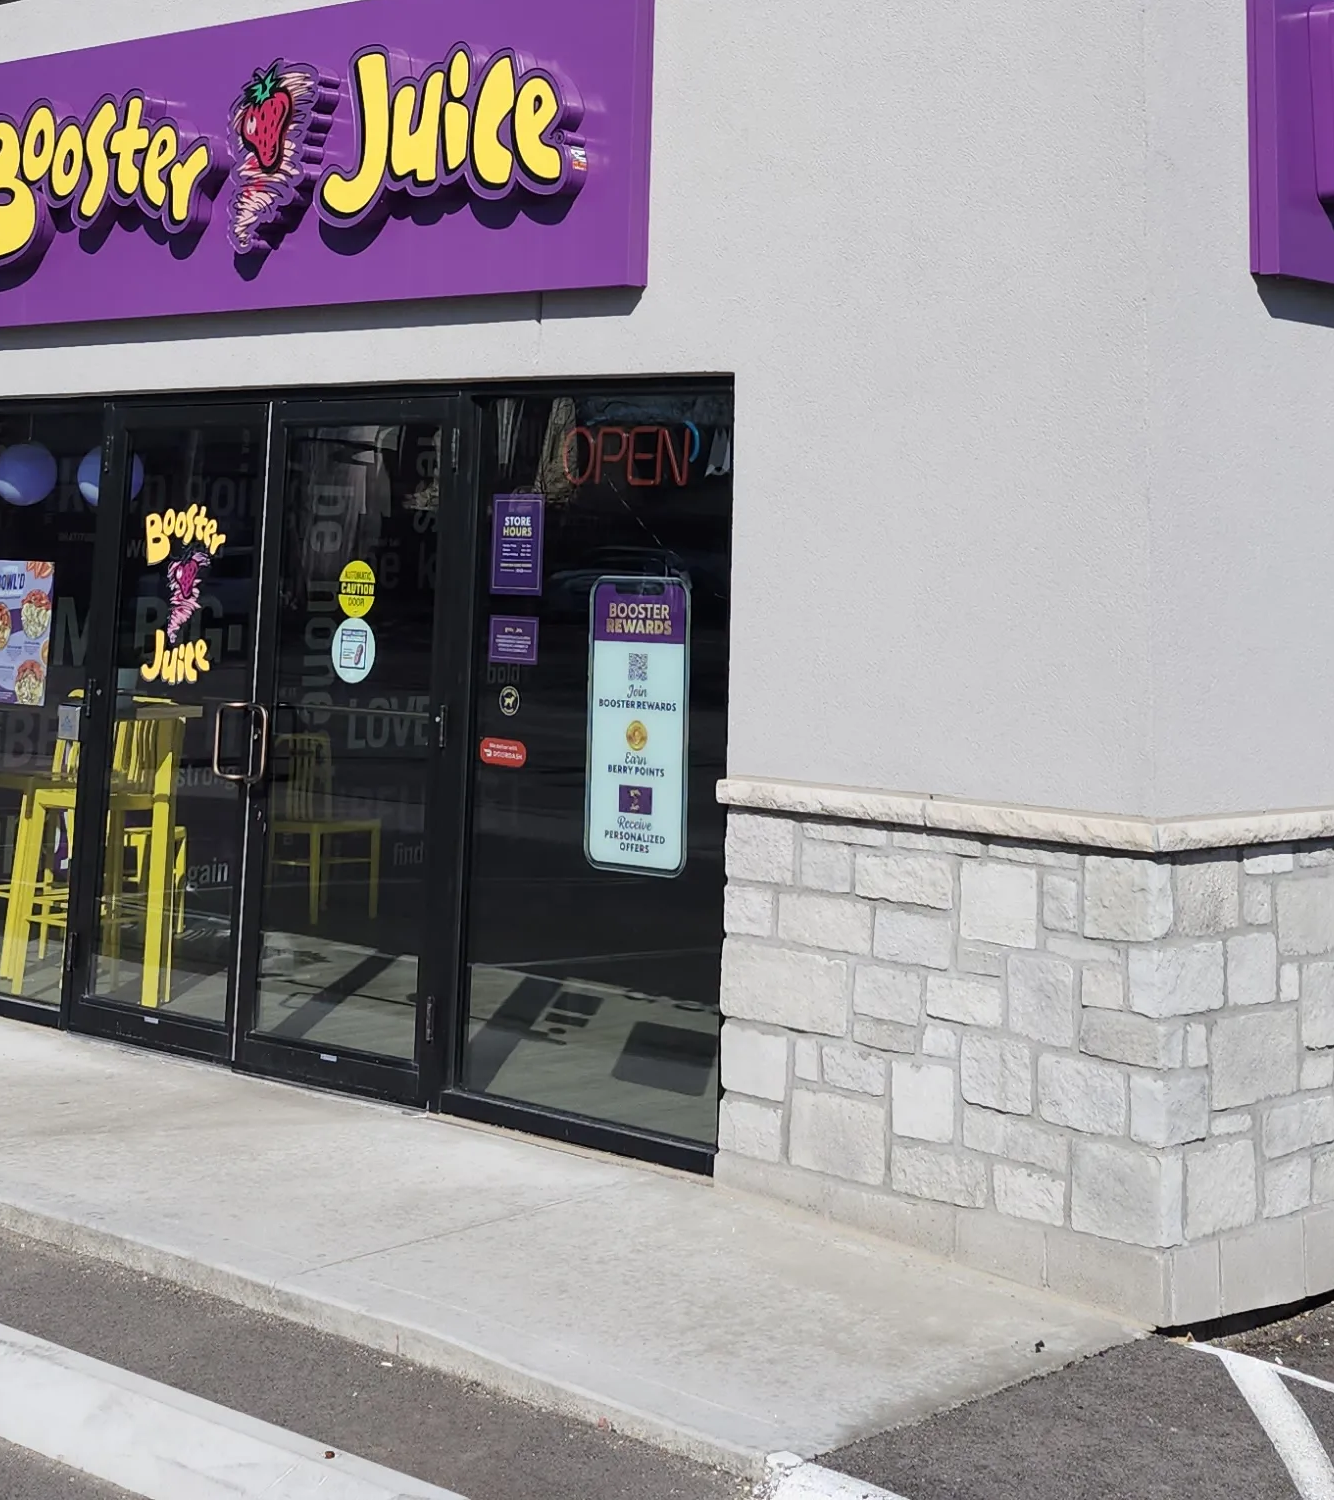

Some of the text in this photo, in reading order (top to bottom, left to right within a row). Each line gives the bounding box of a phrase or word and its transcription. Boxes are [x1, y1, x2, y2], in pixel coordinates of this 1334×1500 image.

[323, 50, 563, 214] Juice
[563, 425, 692, 487] OPEN
[504, 516, 532, 527] STORE
[146, 503, 226, 567] Booster
[503, 526, 533, 537] HOURS
[341, 582, 375, 596] CAUTION
[348, 597, 365, 608] DOOR
[609, 602, 670, 619] BOOSTER
[606, 618, 672, 636] REWARDS
[140, 628, 211, 686] Juice
[627, 684, 647, 699] Join
[598, 698, 677, 712] BOOSTER REWARDS
[625, 752, 647, 766] Earn
[608, 764, 665, 778] BERRY POINTS
[617, 815, 652, 831] Receive
[604, 829, 666, 845] PERSONALIZED
[619, 842, 650, 854] OFFERS
